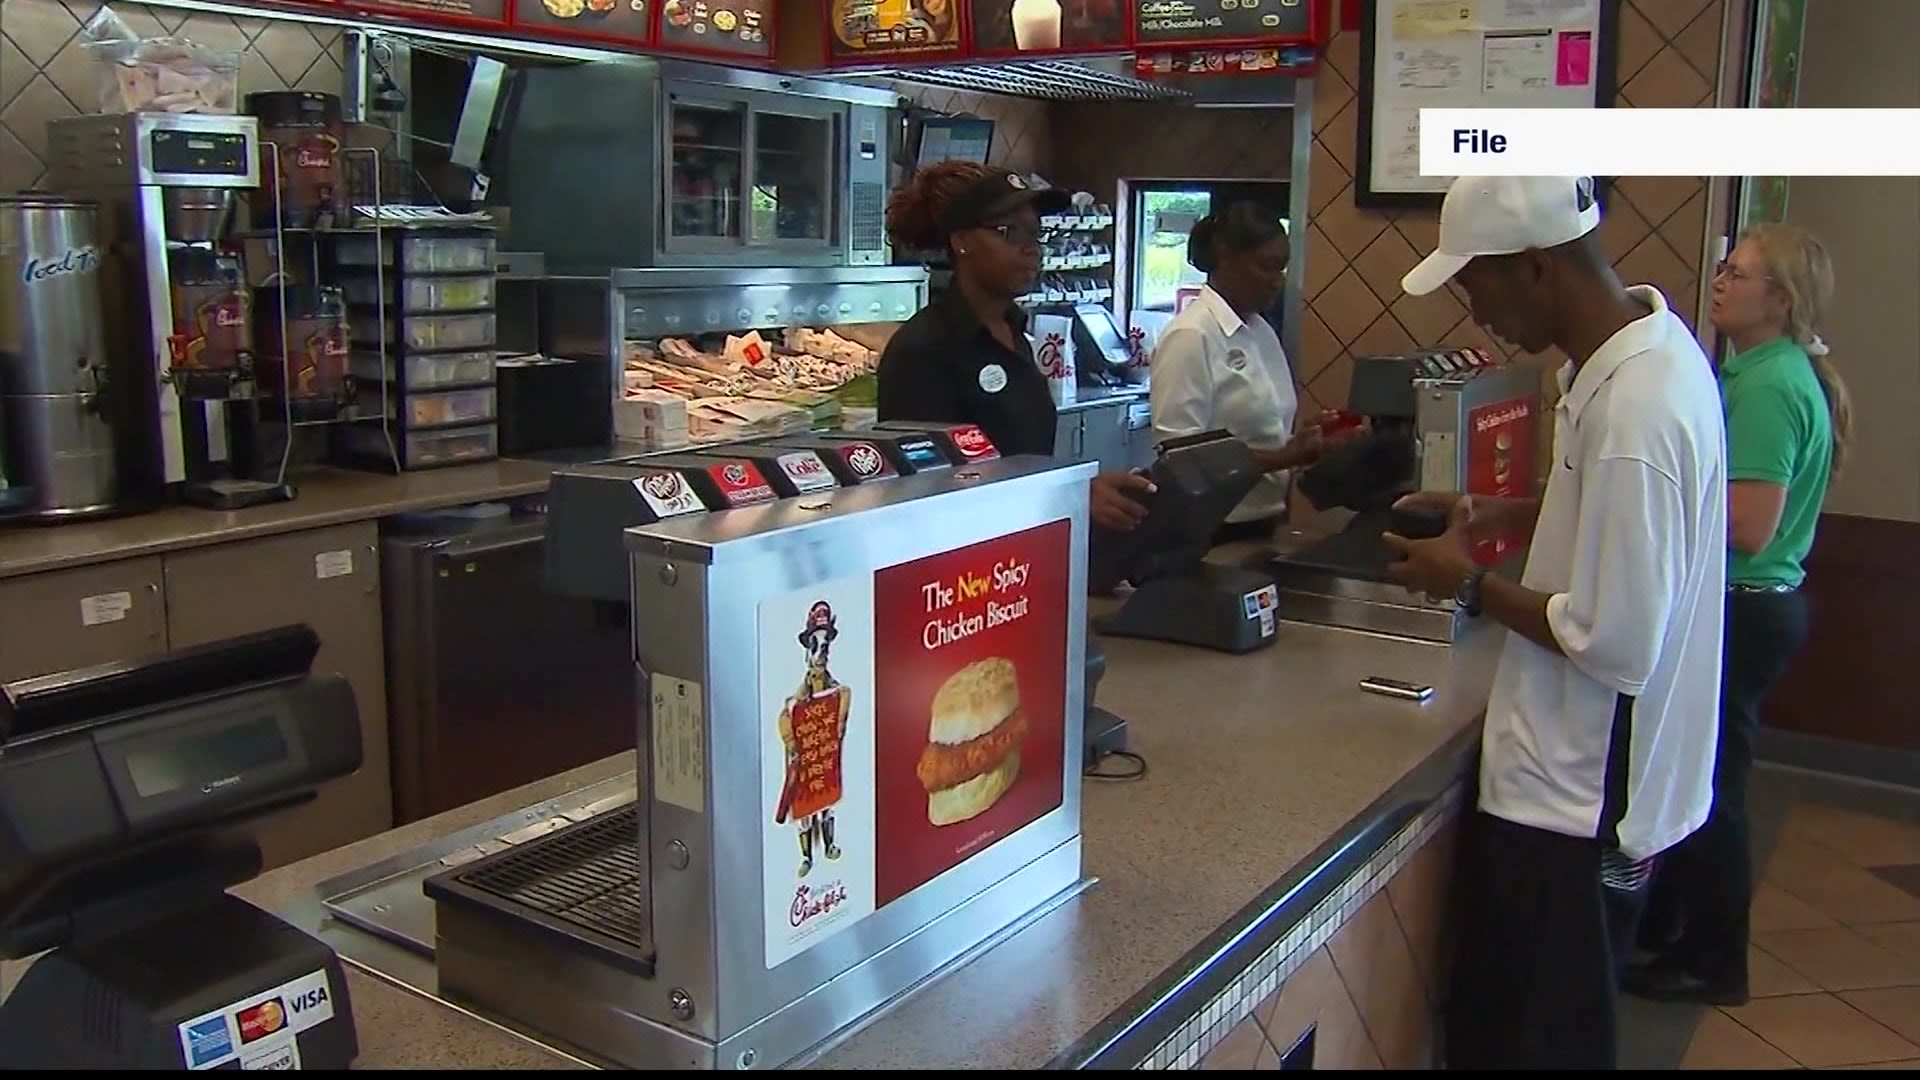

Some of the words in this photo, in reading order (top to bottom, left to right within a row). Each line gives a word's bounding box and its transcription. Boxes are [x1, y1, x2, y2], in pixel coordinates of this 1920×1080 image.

[922, 580, 953, 612] The
[957, 571, 992, 602] New
[993, 557, 1030, 593] Spicy
[923, 611, 983, 649] Chicken
[986, 595, 1028, 628] Biscuit
[290, 987, 328, 1013] VISA
